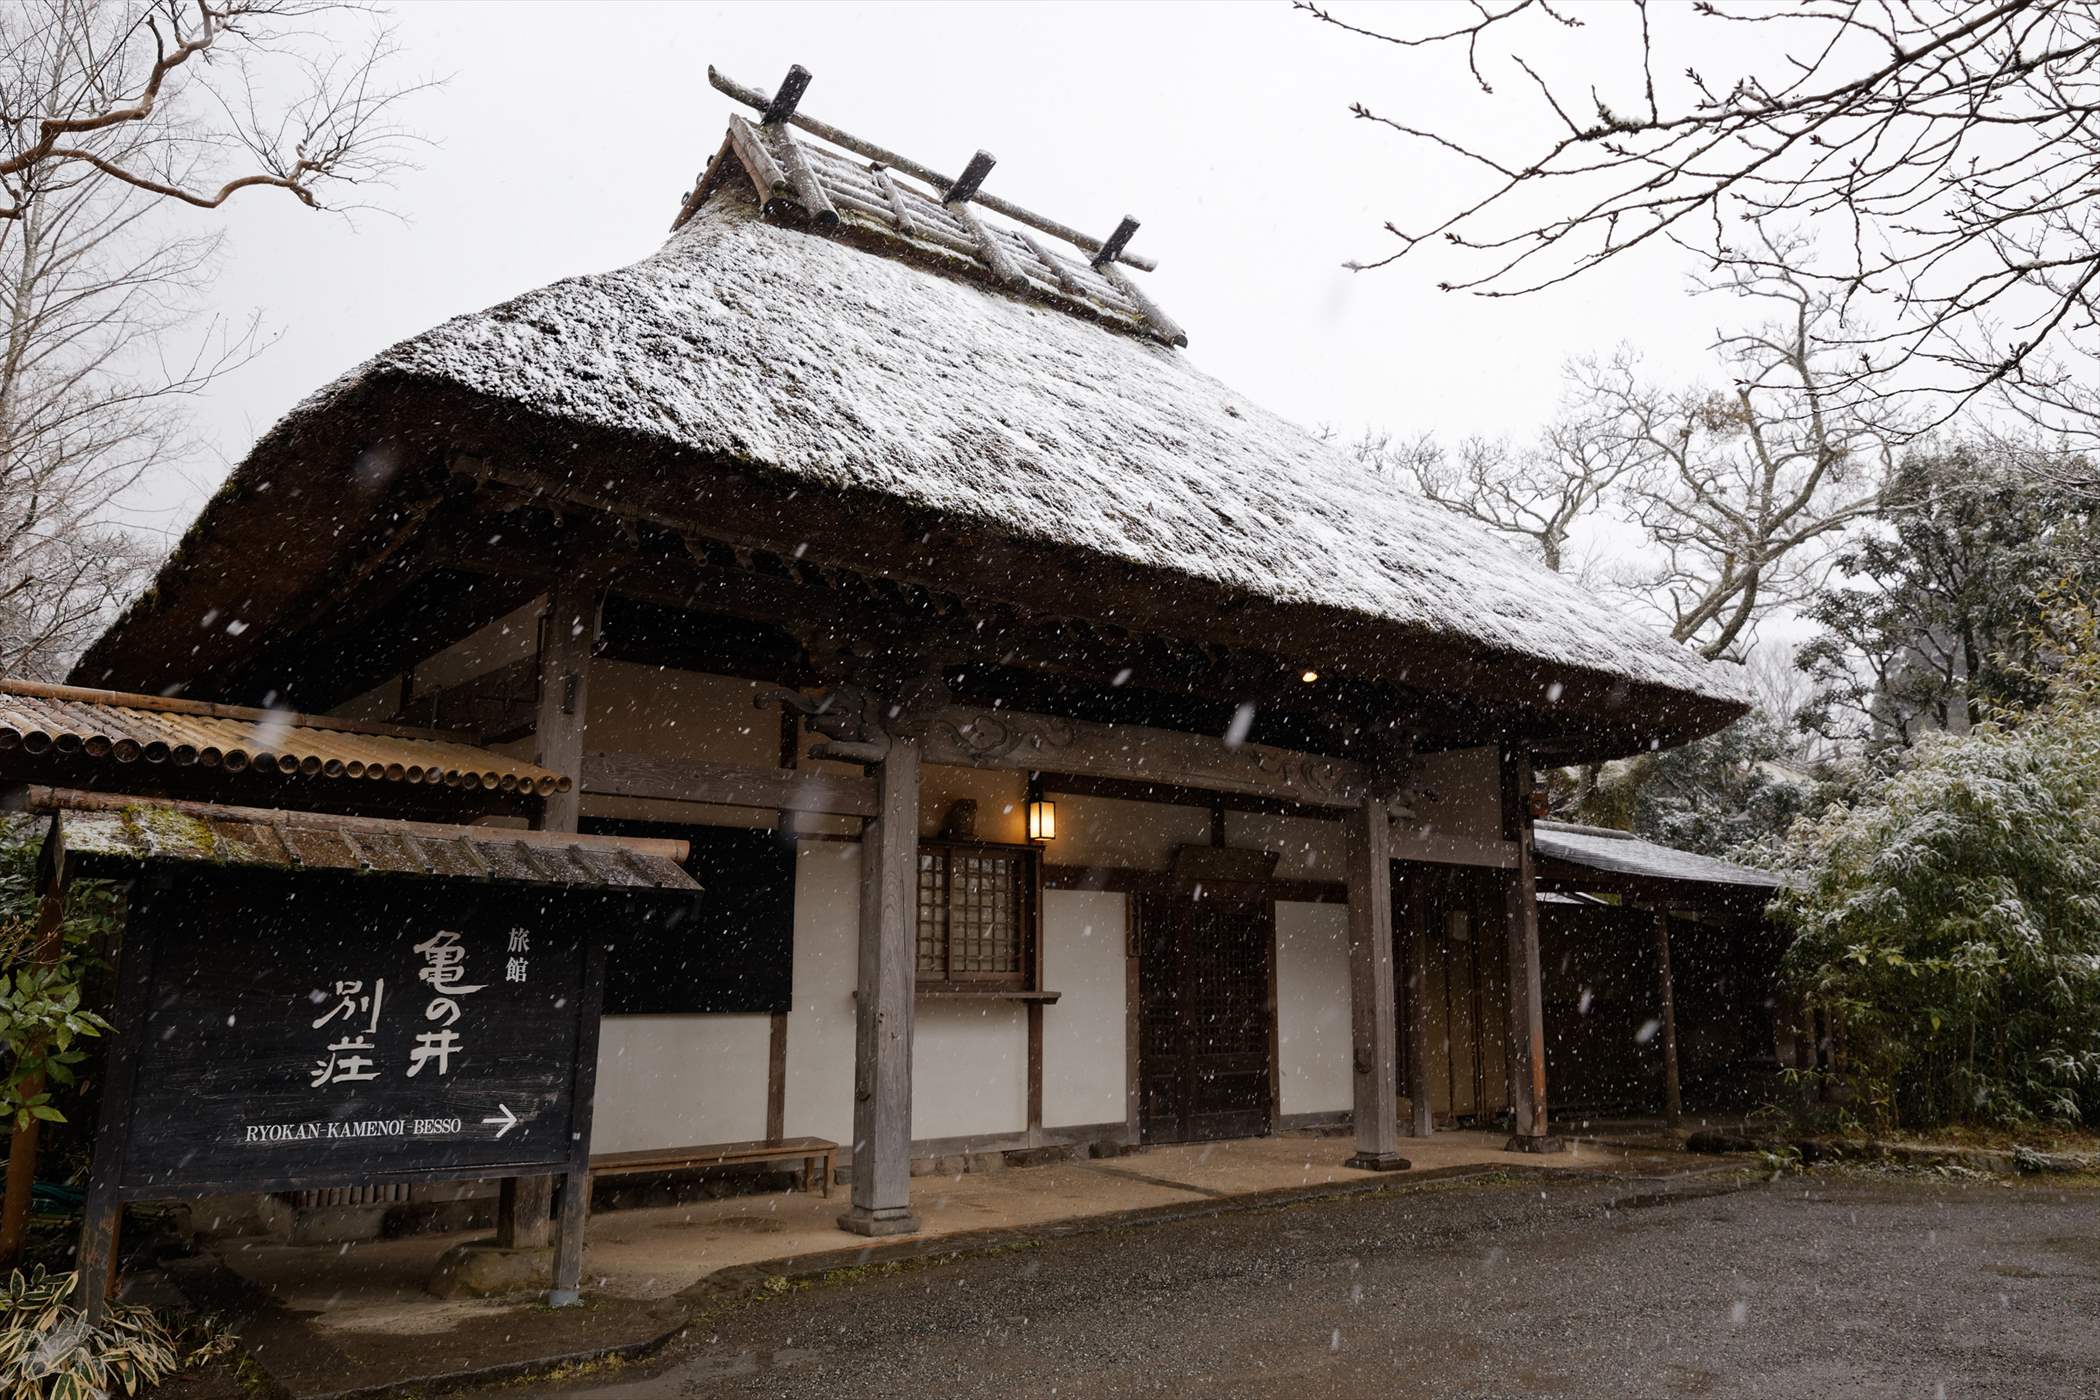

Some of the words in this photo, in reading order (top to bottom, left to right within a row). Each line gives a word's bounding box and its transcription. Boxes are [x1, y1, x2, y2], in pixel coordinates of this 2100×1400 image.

[407, 930, 488, 1078] 亀の井
[506, 928, 530, 983] 旅館
[311, 978, 384, 1088] 別荘
